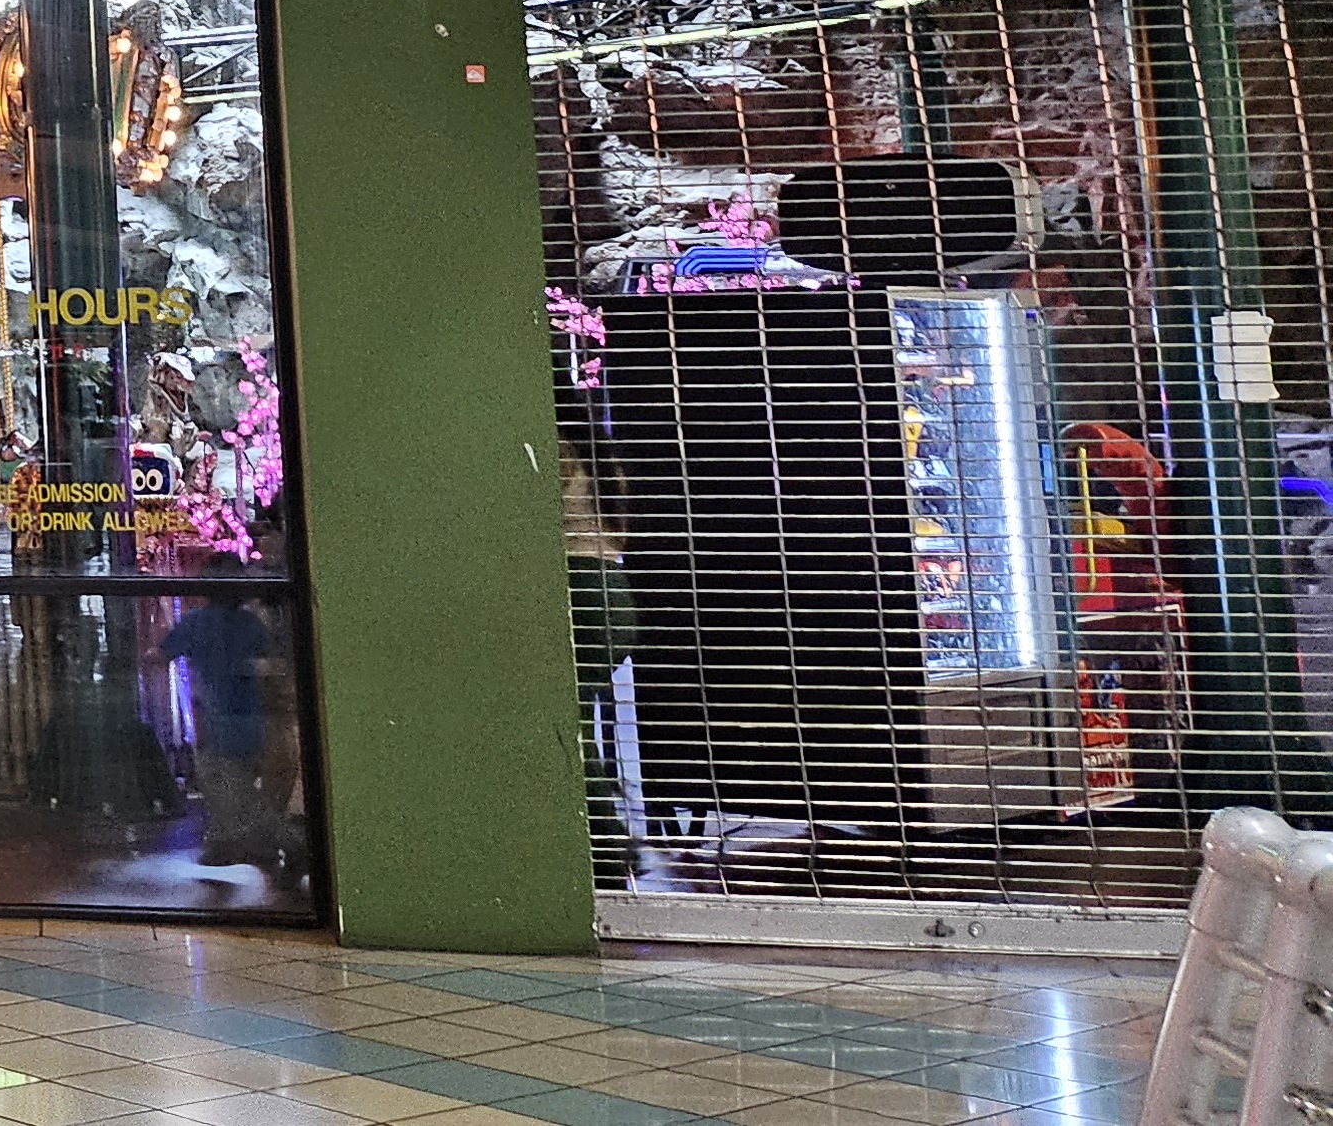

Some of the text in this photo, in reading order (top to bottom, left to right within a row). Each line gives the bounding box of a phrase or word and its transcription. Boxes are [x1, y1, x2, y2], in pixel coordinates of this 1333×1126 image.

[27, 287, 192, 325] HOURS
[27, 483, 126, 502] ADMISSION
[8, 513, 33, 532] OR
[40, 512, 95, 531] DRINK
[102, 511, 191, 531] ALLOWED
